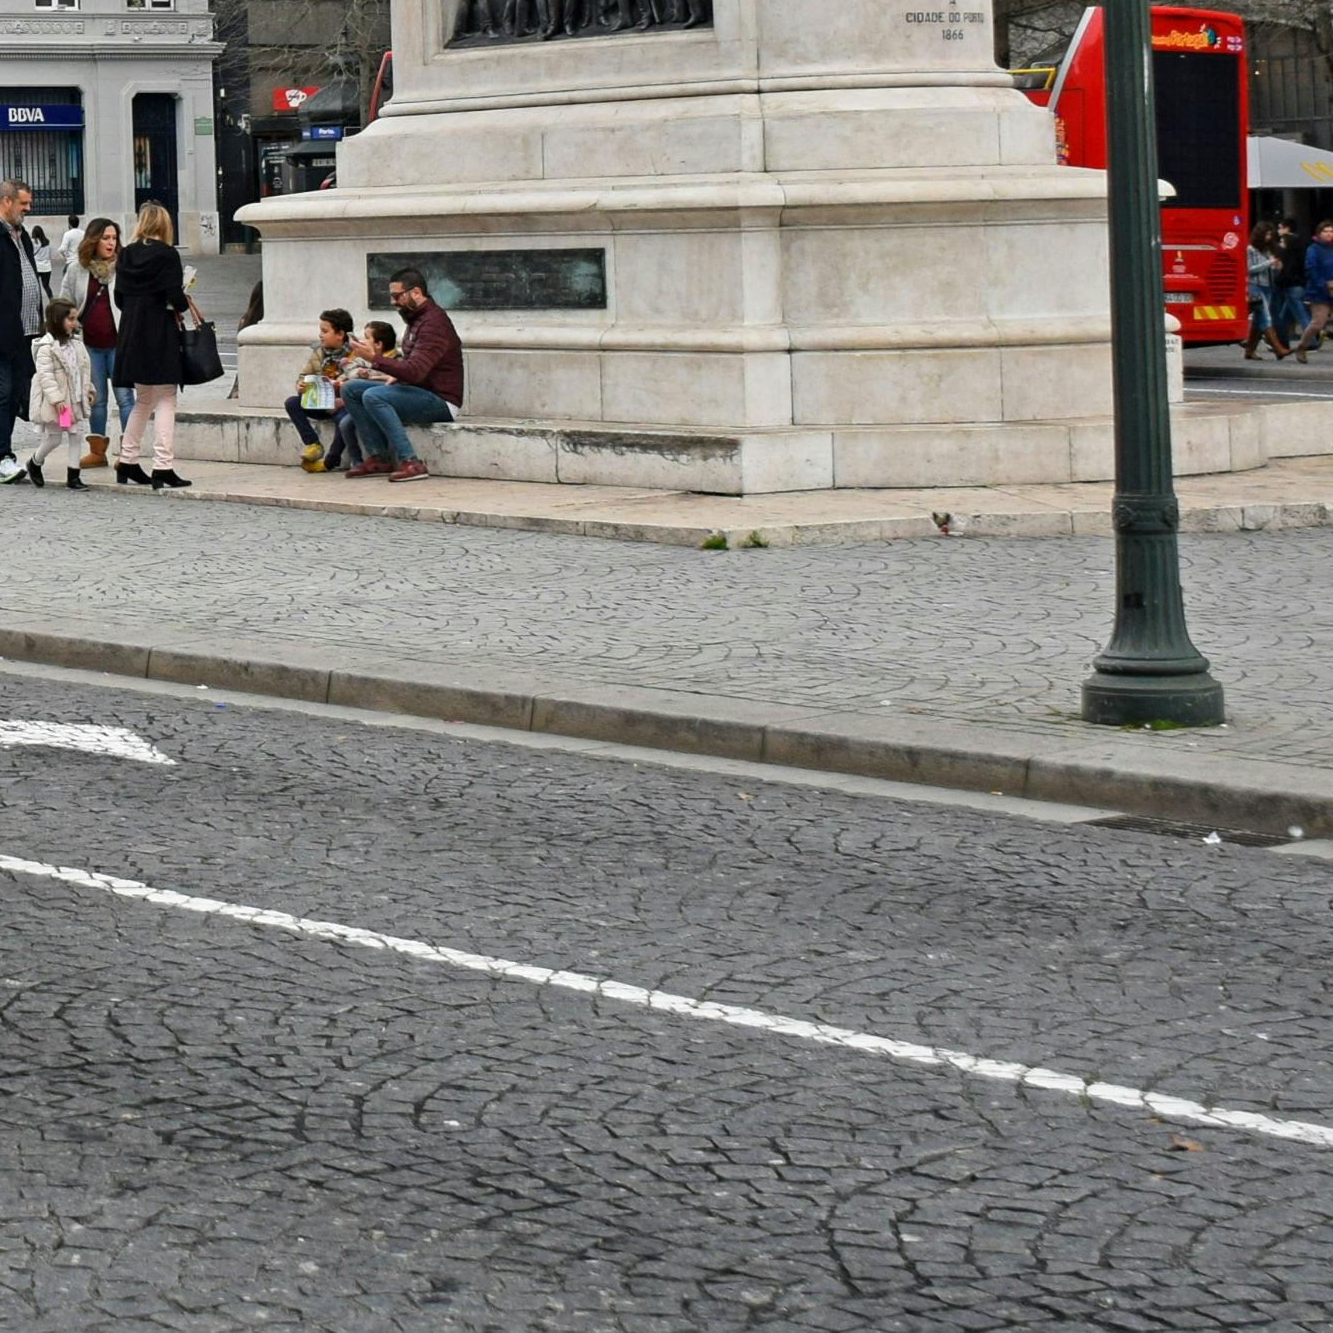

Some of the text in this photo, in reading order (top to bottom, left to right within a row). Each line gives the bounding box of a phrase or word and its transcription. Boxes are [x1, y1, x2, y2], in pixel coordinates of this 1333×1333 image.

[906, 12, 945, 23] CIDADE
[949, 12, 961, 23] DO
[942, 29, 964, 40] 1866
[8, 108, 45, 122] BBVA
